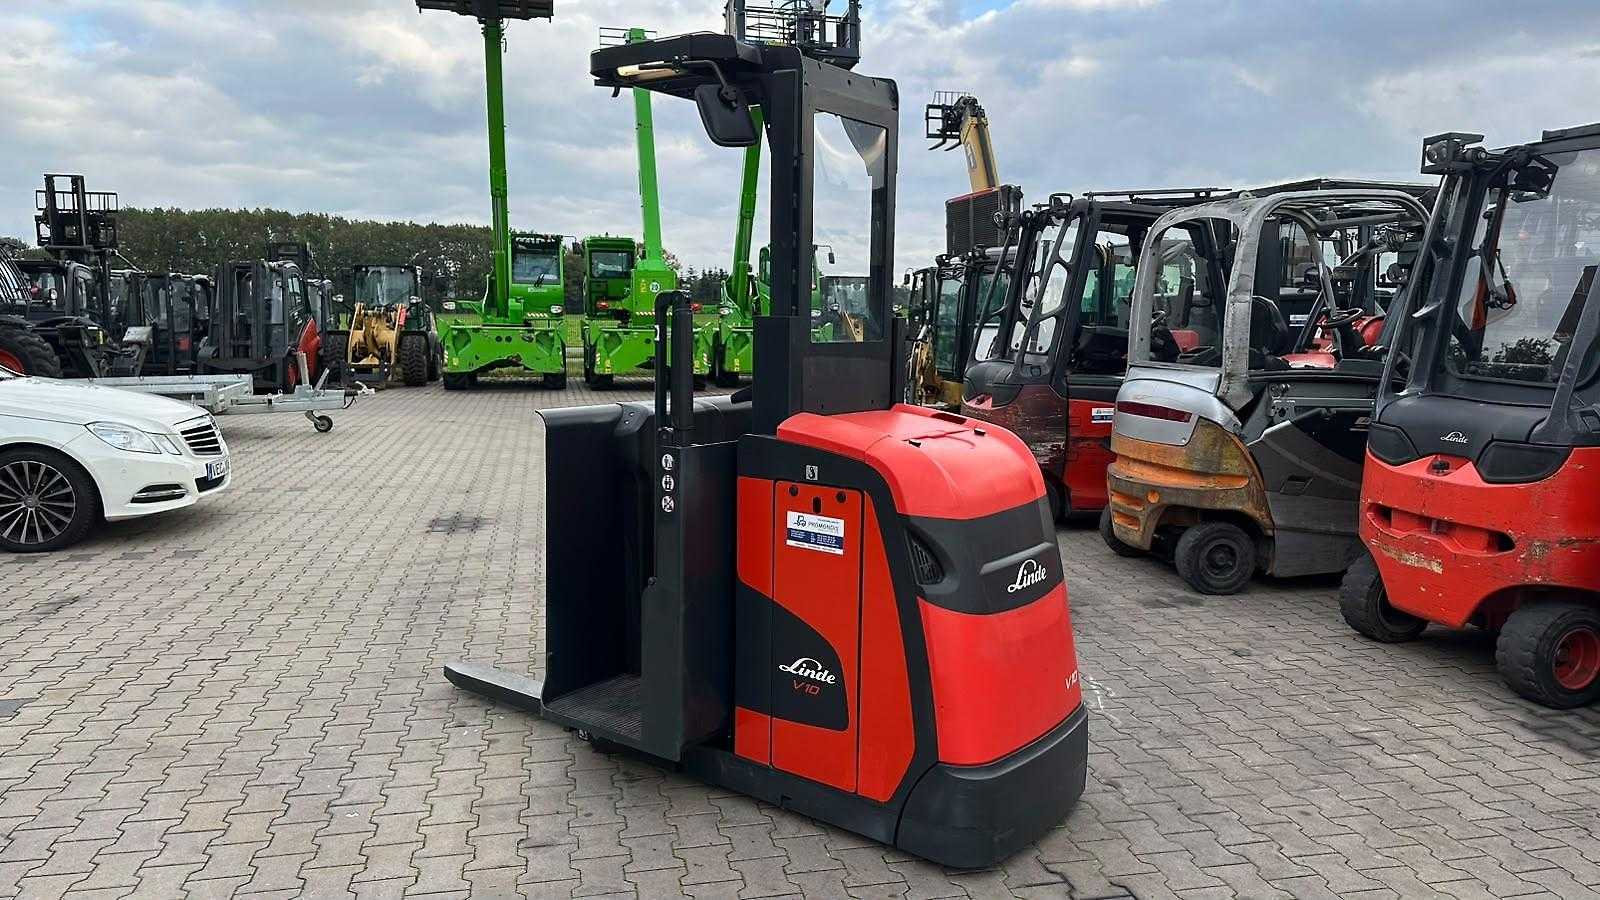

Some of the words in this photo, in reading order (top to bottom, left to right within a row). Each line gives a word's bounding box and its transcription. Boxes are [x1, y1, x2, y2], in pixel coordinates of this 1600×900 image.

[1440, 431, 1468, 443] Linde
[1007, 559, 1047, 592] Linde
[779, 658, 836, 684] Linde
[794, 680, 820, 695] V10
